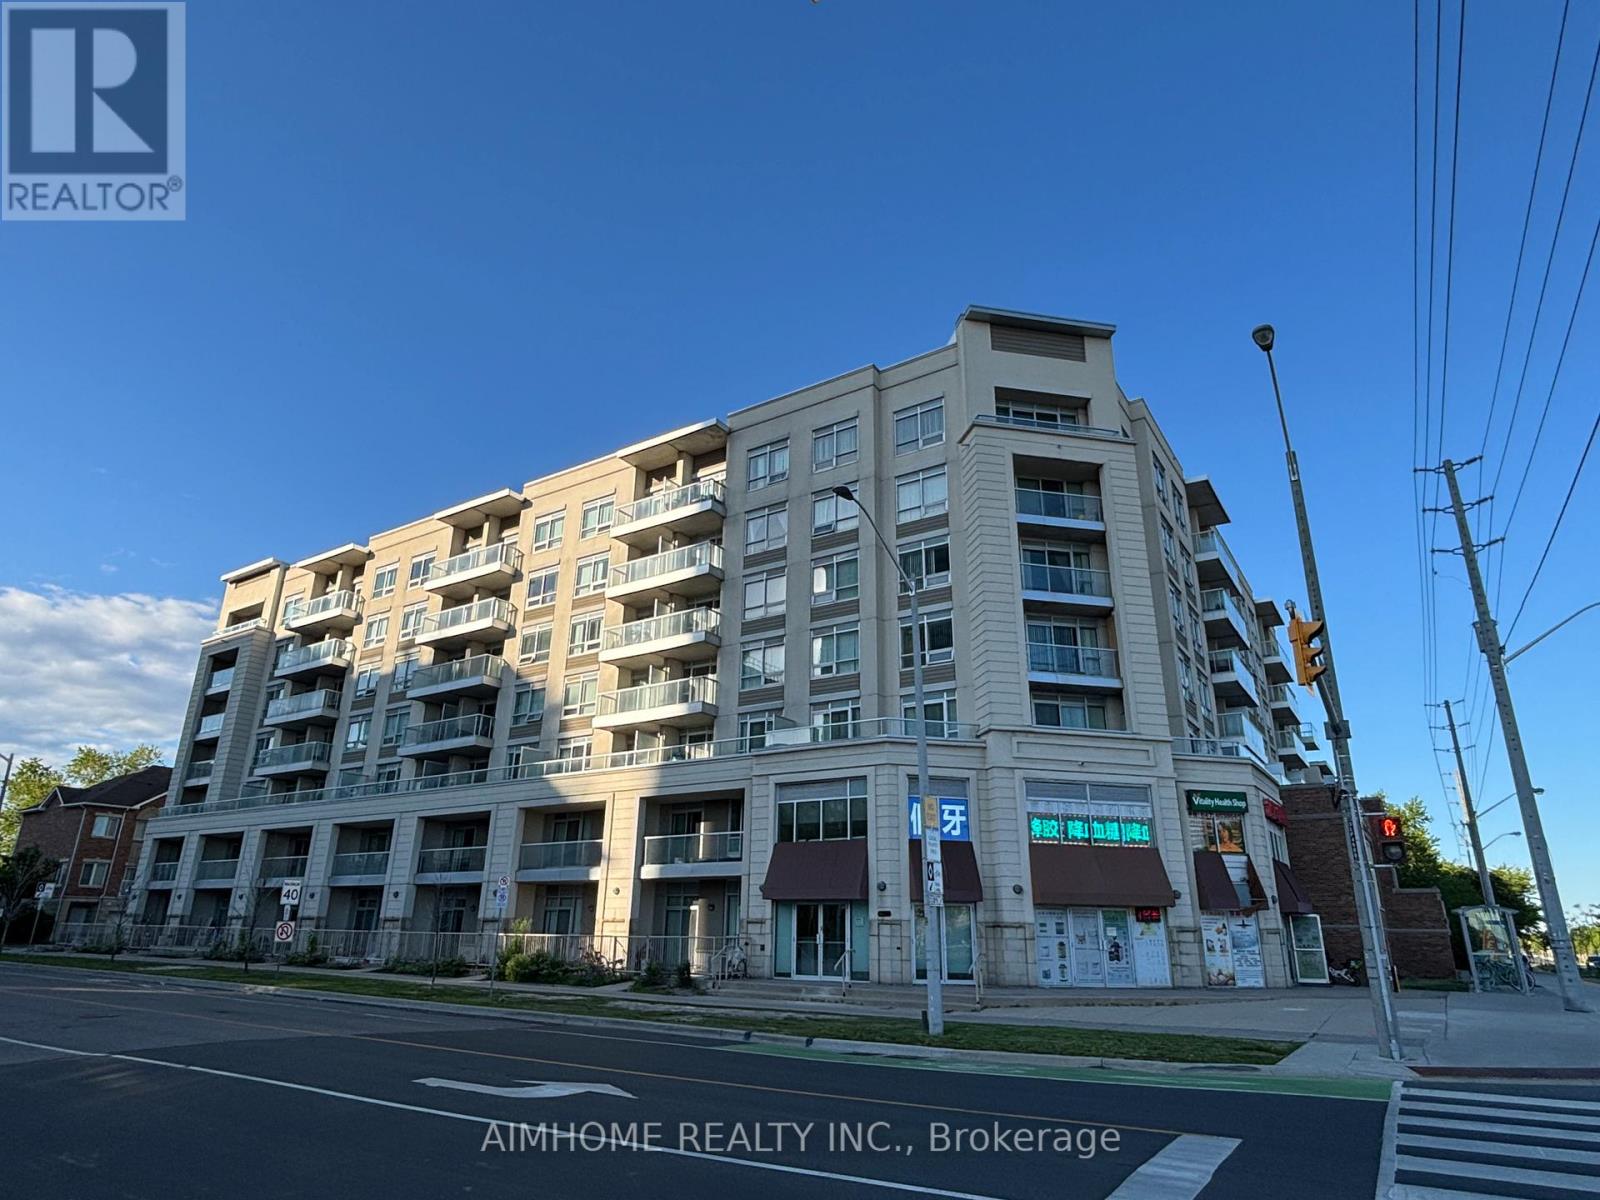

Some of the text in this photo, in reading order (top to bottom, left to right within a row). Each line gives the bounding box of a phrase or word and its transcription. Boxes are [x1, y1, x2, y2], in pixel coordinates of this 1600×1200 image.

[1192, 796, 1247, 809] Vitality Health Shop
[283, 888, 299, 901] 40
